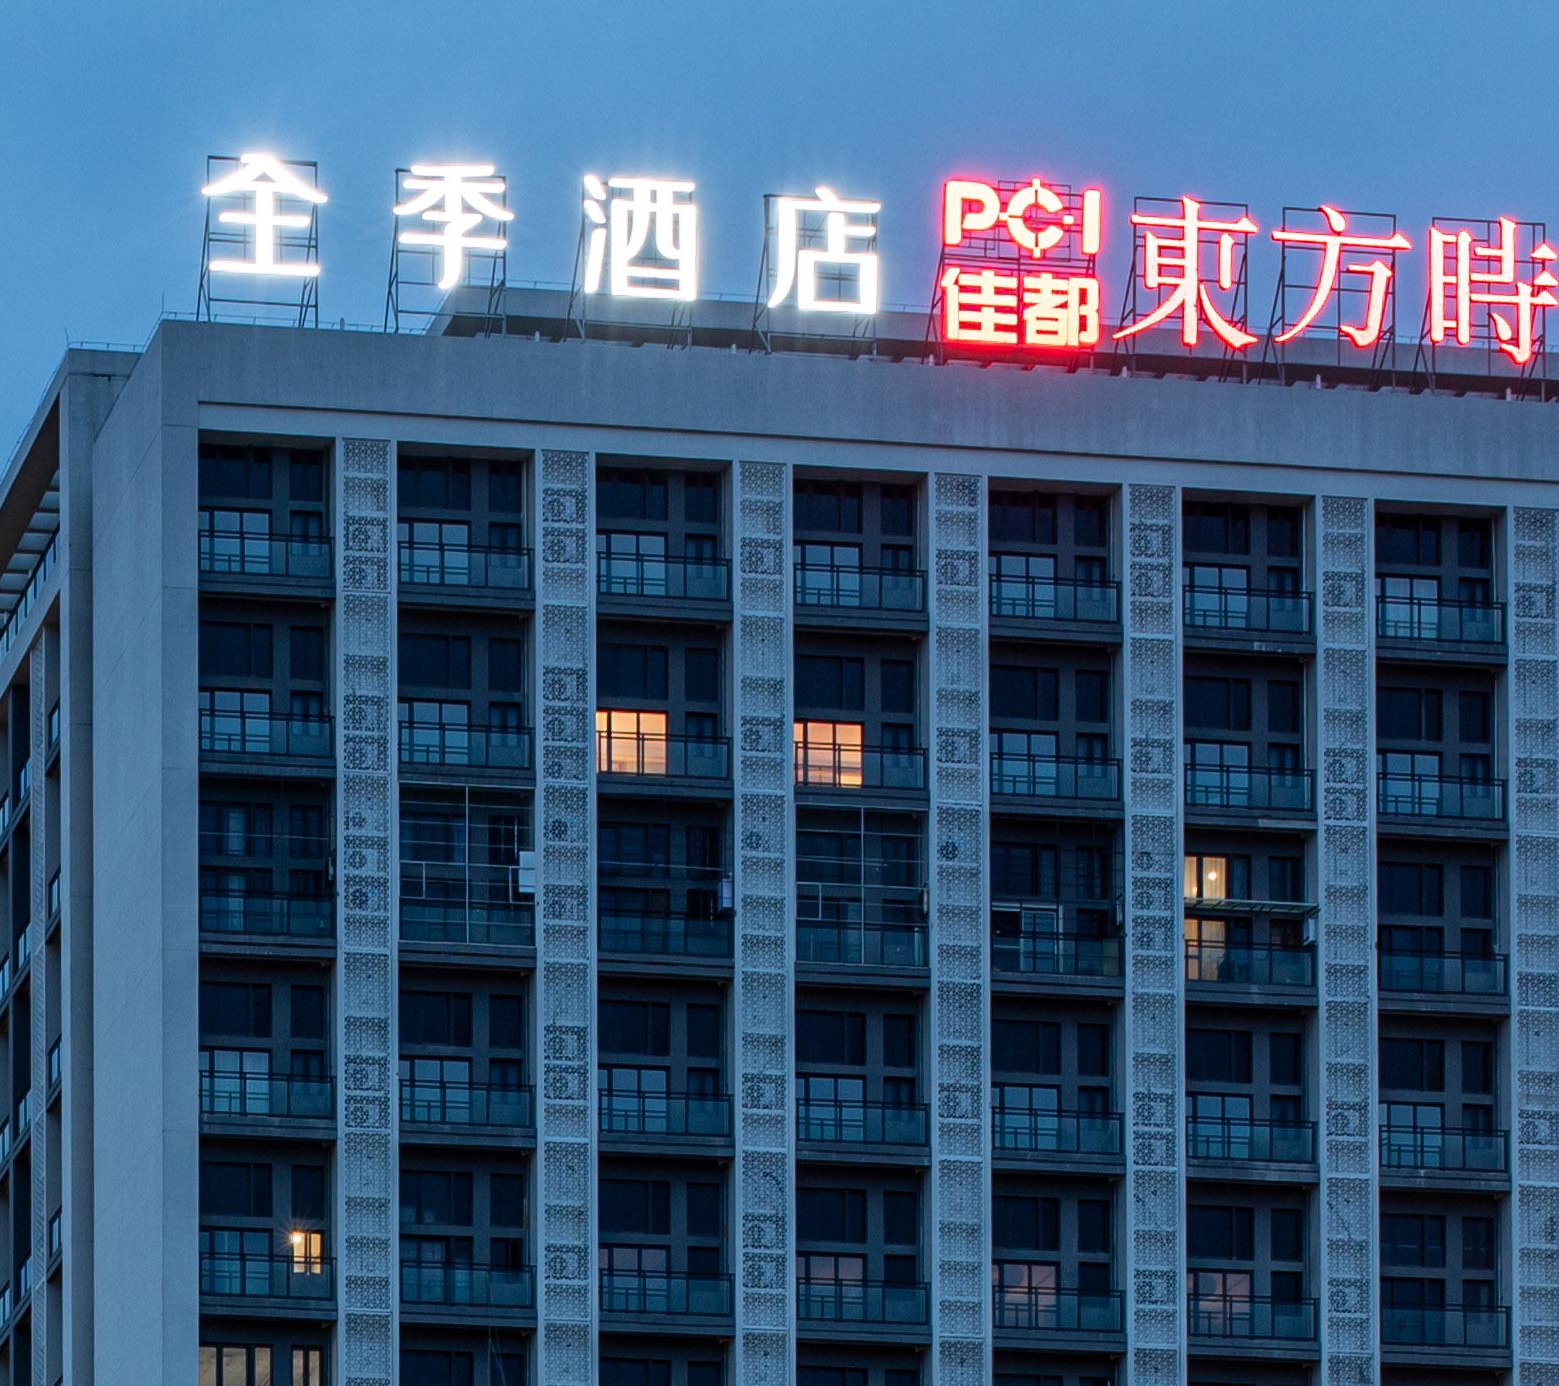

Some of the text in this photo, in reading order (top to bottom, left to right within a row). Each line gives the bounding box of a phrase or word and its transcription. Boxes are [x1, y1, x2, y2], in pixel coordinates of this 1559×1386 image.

[201, 152, 882, 314] 全季酒店
[943, 178, 1102, 258] PCI
[940, 266, 1101, 348] 佳都
